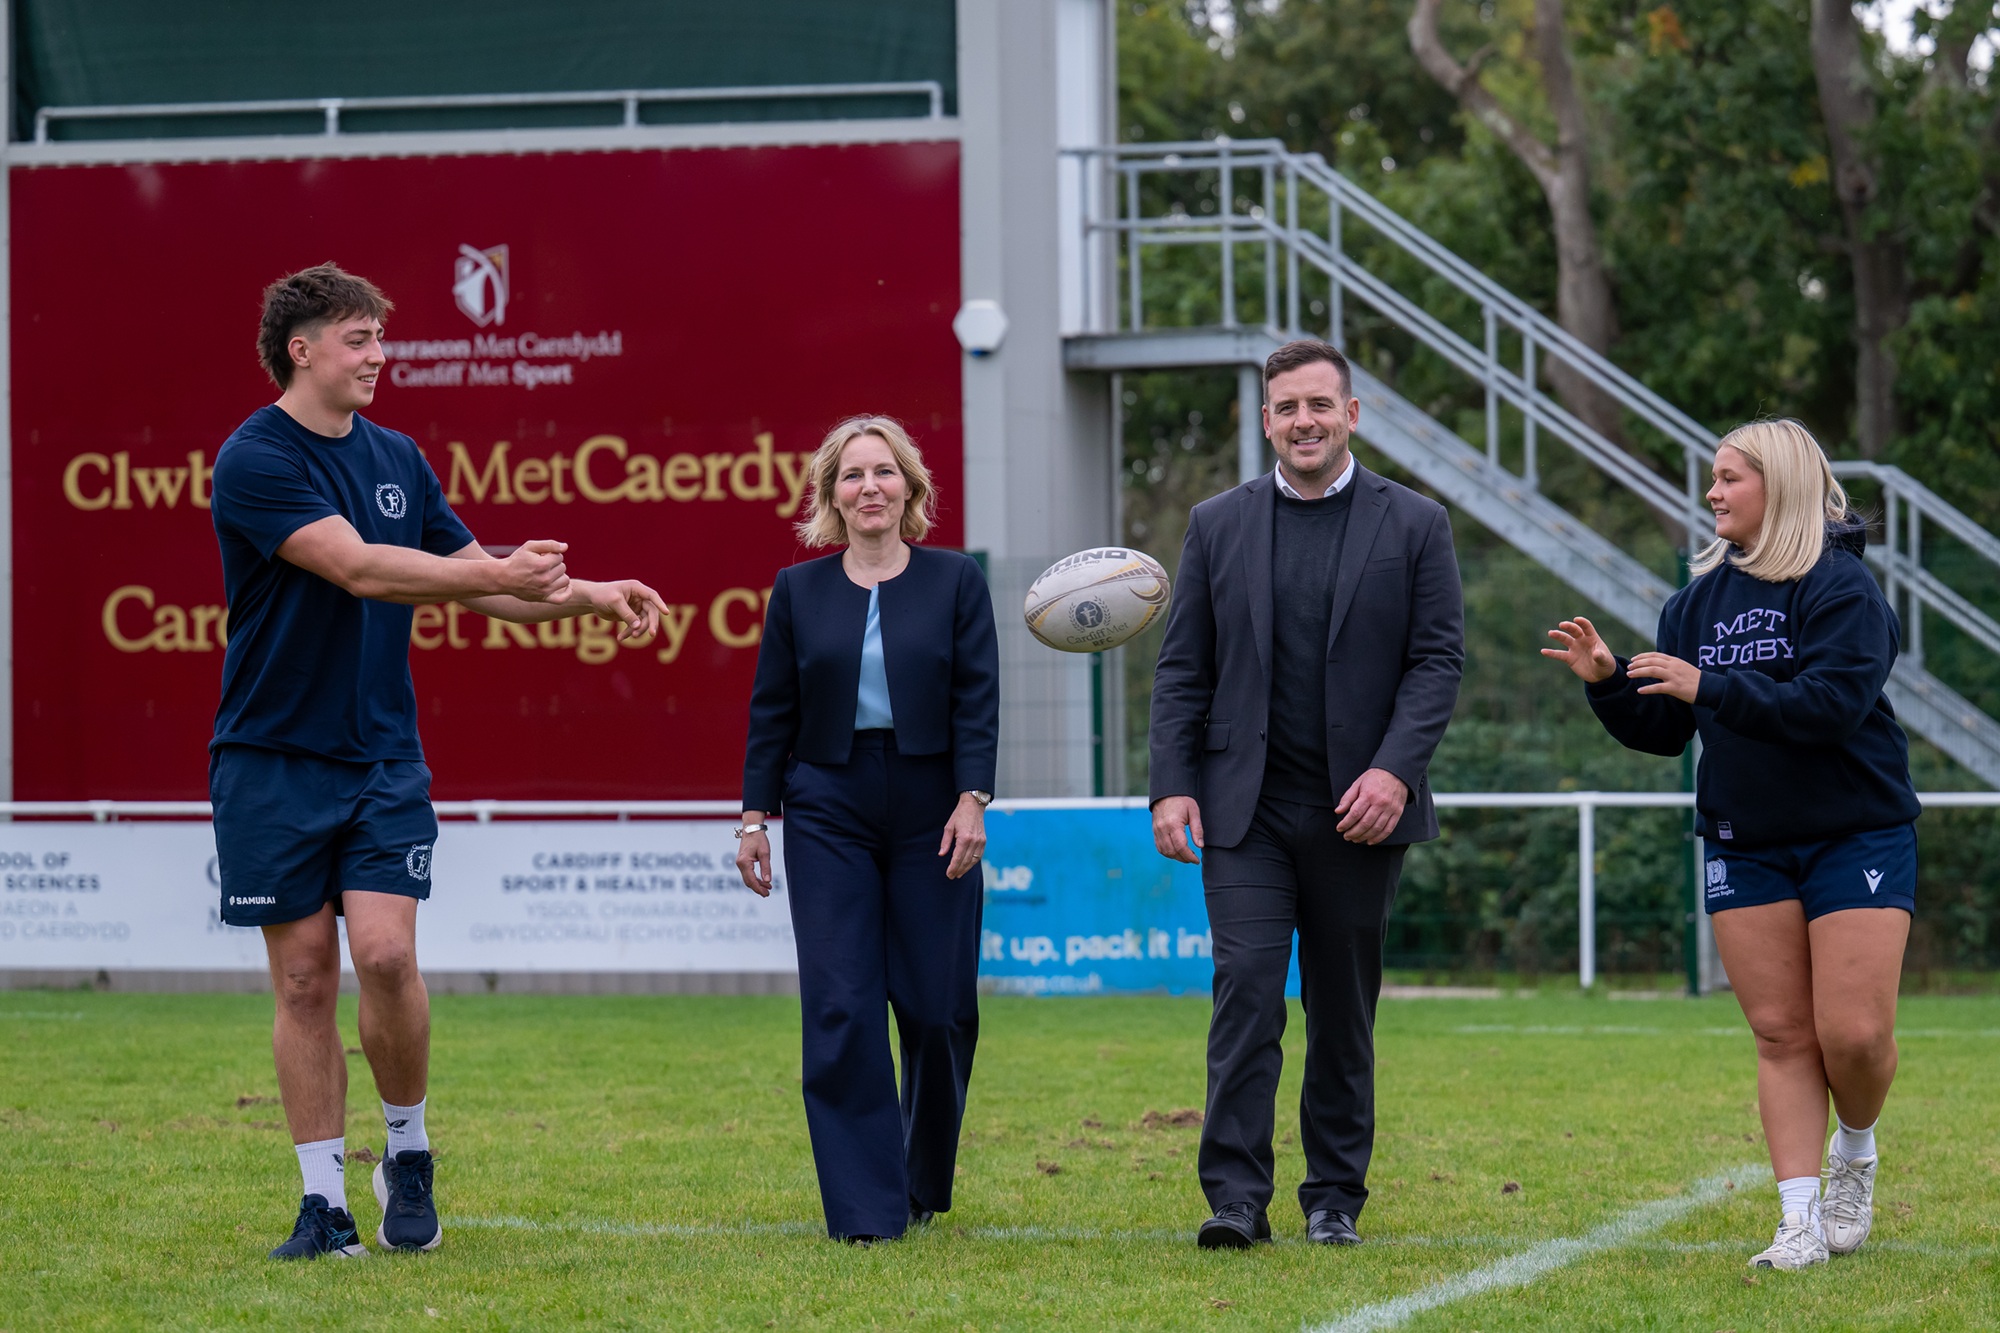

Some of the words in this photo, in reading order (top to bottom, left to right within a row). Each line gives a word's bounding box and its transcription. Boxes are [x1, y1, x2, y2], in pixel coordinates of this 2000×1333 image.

[390, 361, 466, 389] Cardiff
[468, 361, 510, 387] Met
[511, 360, 574, 391] Sport
[447, 432, 812, 519] MetCaerdy
[1713, 608, 1787, 642] MET
[1092, 636, 1114, 647] RFC
[1698, 637, 1794, 668] RUGBY
[43, 852, 71, 871] OF
[531, 852, 623, 871] CARDIFF
[629, 852, 714, 871] SCHOOL
[721, 852, 739, 871] O
[5, 874, 101, 893] SCIENCES
[501, 875, 568, 894] SPORT
[574, 875, 589, 893] &
[594, 875, 676, 893] HEALTH
[982, 860, 1034, 890] lue
[236, 896, 276, 905] SAMURAI
[1065, 927, 1143, 966] pack
[1148, 927, 1170, 959] it
